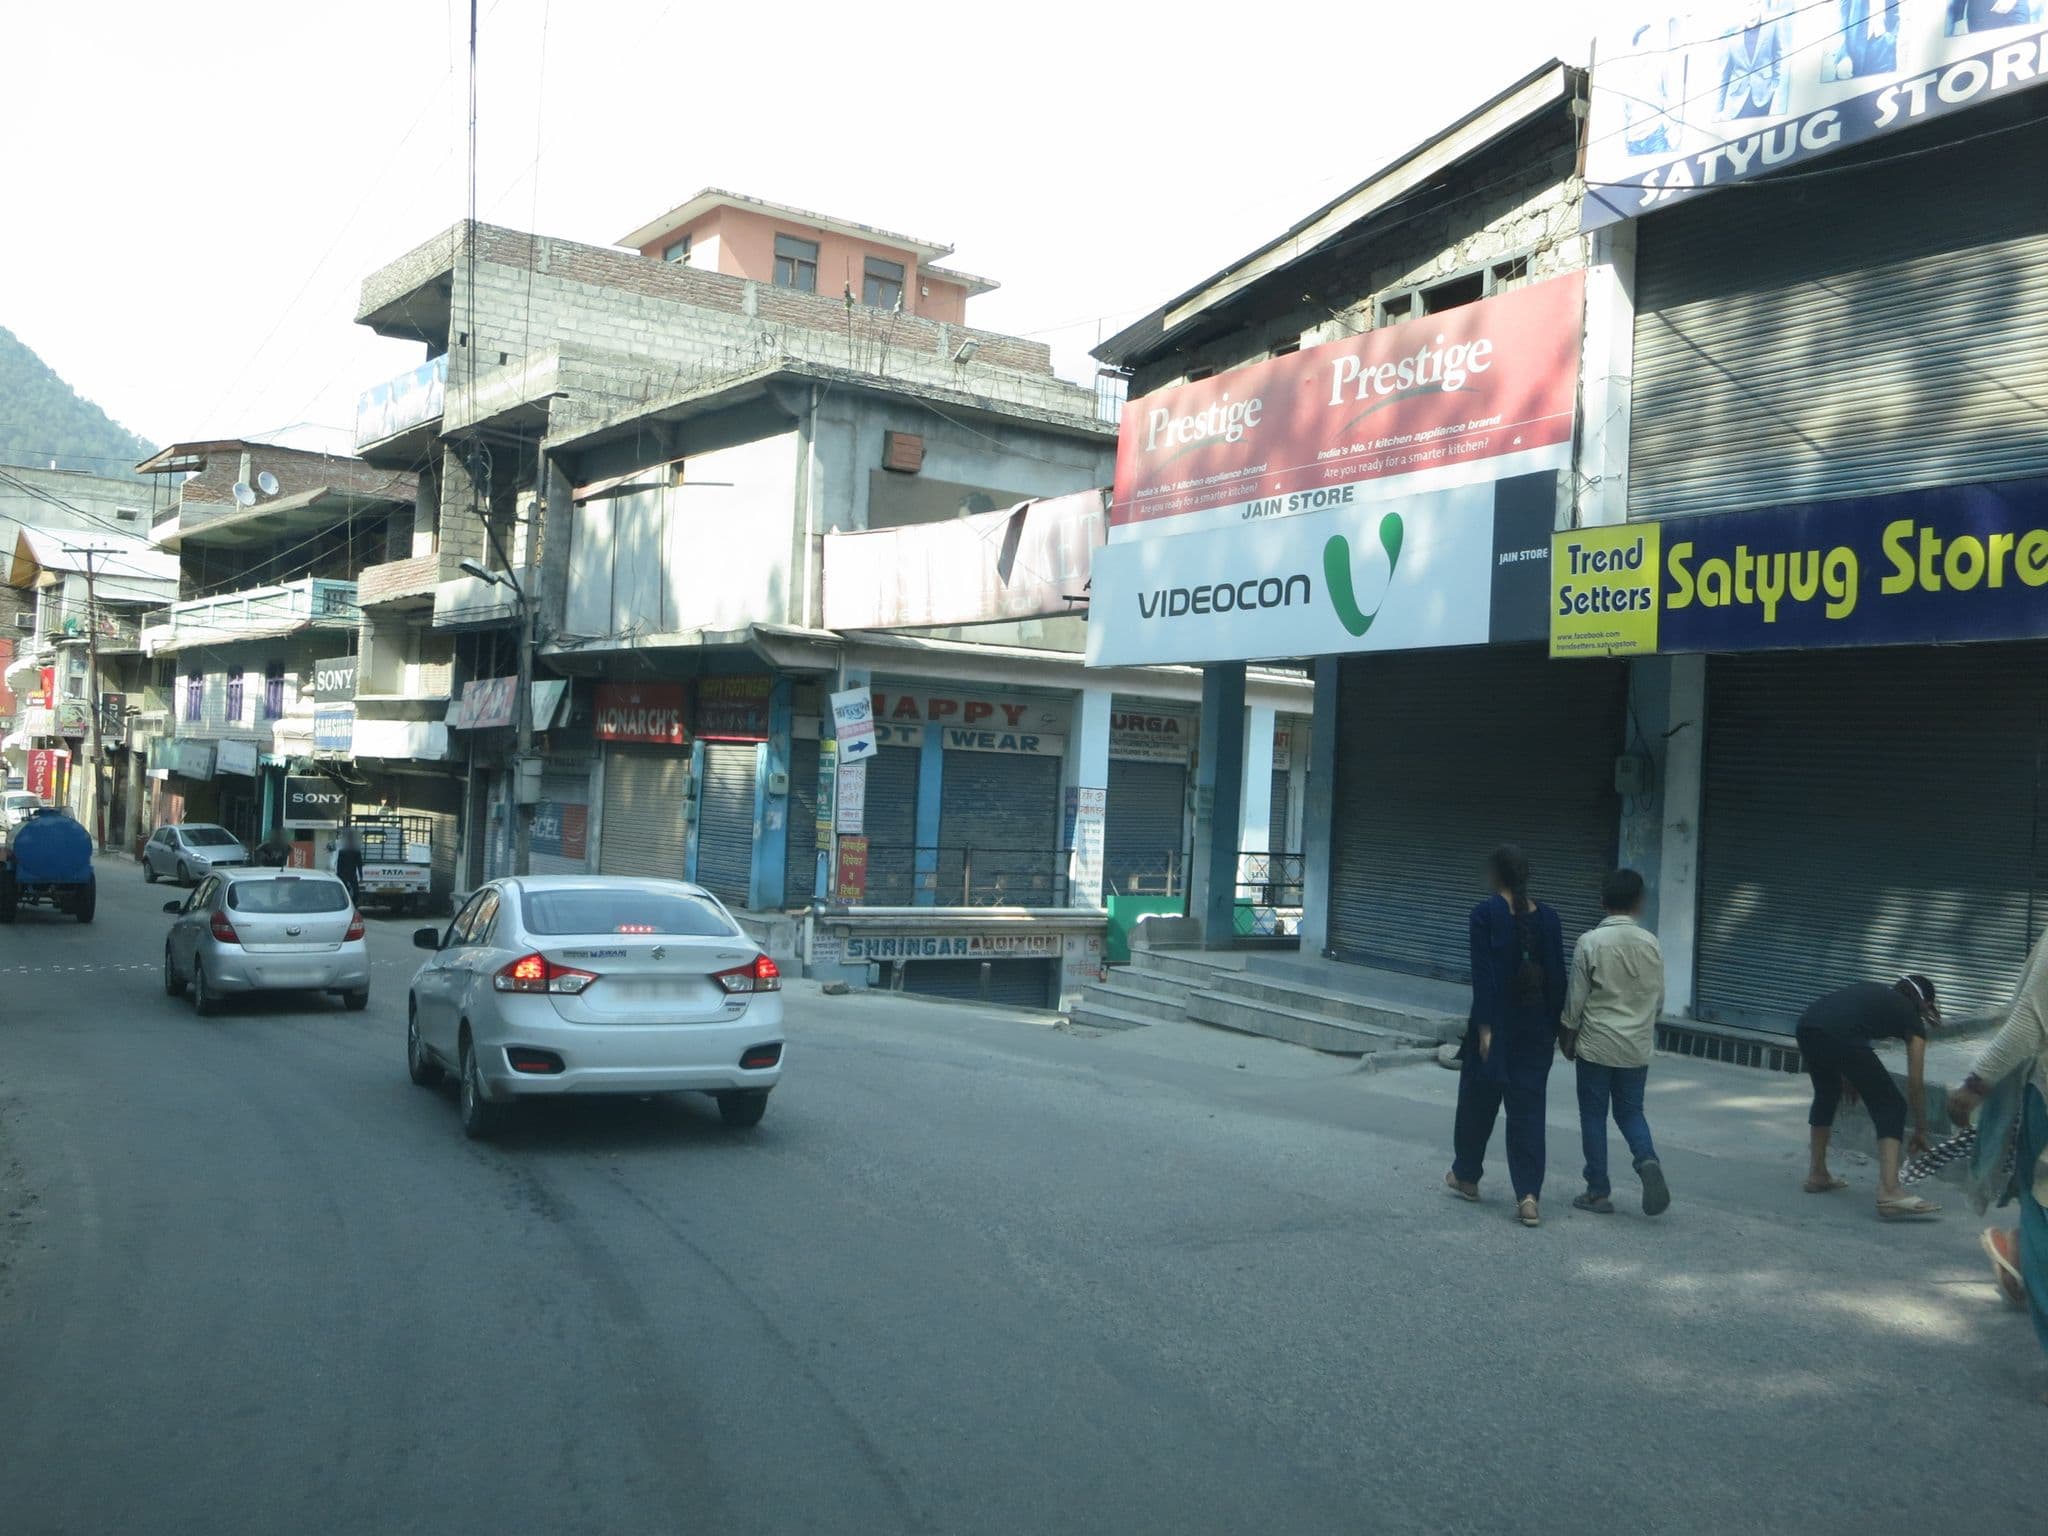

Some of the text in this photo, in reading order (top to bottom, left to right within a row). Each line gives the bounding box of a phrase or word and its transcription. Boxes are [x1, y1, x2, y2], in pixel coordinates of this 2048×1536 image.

[1638, 35, 2048, 208] SATYUG STOR
[1328, 334, 1493, 406] Prestige
[1145, 392, 1262, 452] Prestige
[1317, 413, 1502, 460] India's No.1 kitchen appliance brand
[1323, 467, 1340, 479] Are
[1339, 463, 1357, 479] you
[1359, 457, 1384, 473] ready
[1385, 455, 1400, 467] for
[1408, 448, 1446, 463] smarter
[1448, 437, 1489, 455] kitchen?
[1177, 477, 1204, 489] kitchen
[1205, 470, 1242, 485] appliance
[1242, 463, 1268, 475] brand
[1200, 489, 1227, 503] smarter
[1241, 485, 1355, 520] JAIN STORE
[1499, 548, 1548, 565] JAIN STORE
[1567, 537, 1643, 575] Trend
[1666, 519, 2048, 623] Satyug Store
[1137, 574, 1311, 619] VIDEOCON
[1559, 585, 1651, 616] Setters
[1557, 630, 1621, 641] www.facebook.com
[317, 668, 354, 692] SONY
[597, 707, 679, 737] MONARCH'S
[1110, 712, 1180, 734] URGA
[951, 729, 1040, 752] WEAR
[292, 793, 345, 804] SONY
[847, 936, 968, 957] SHRINGAR
